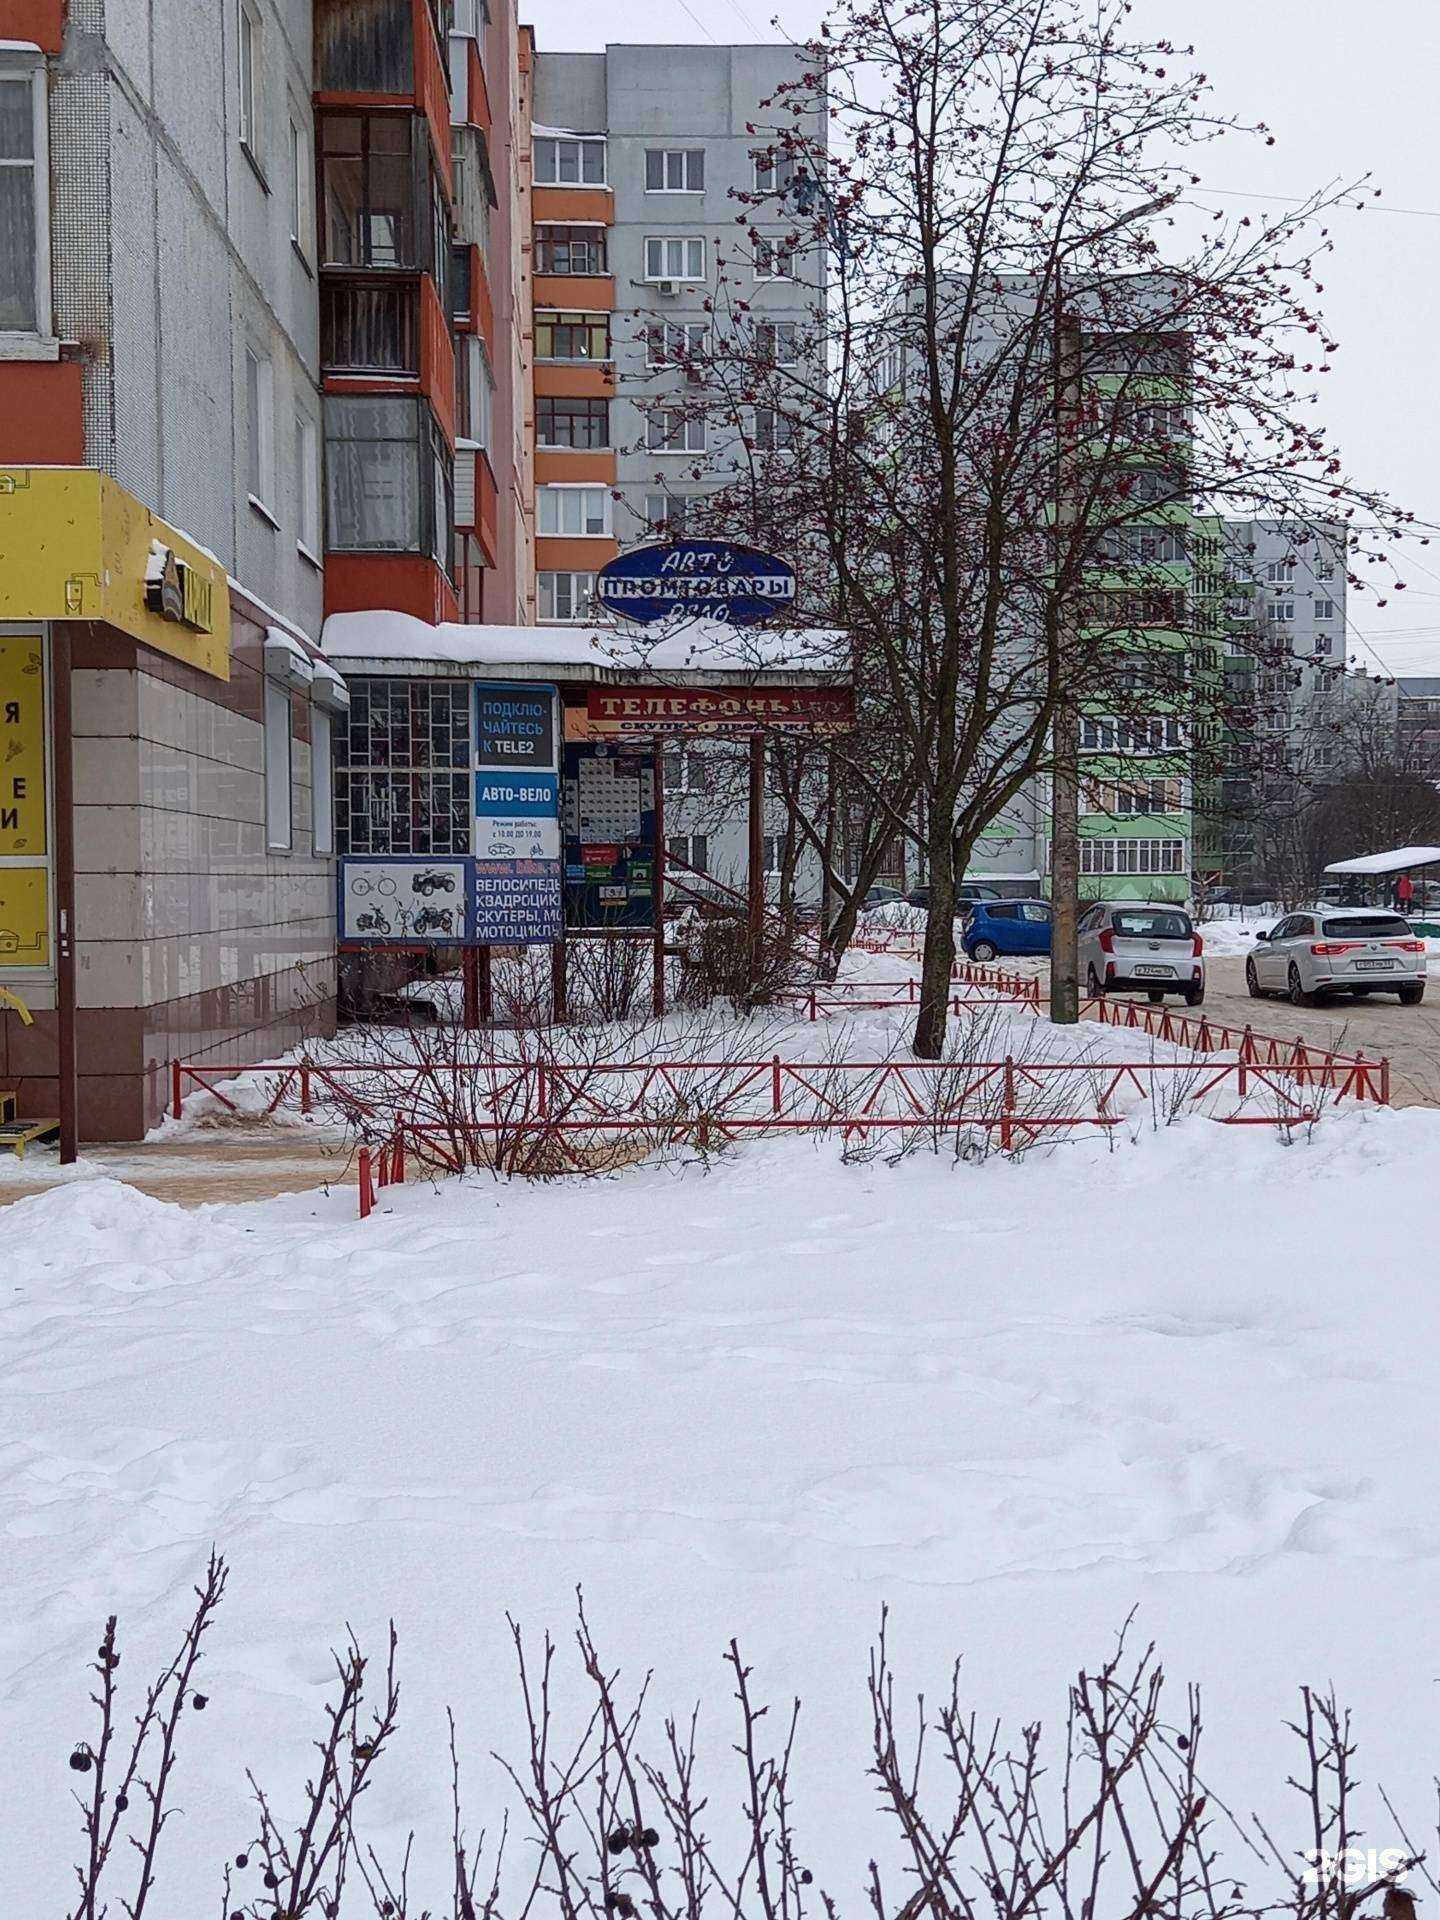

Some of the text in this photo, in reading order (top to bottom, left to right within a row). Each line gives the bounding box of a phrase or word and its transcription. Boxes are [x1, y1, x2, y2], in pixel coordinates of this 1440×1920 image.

[604, 579, 789, 596] ПРОМТОВАРЫ
[483, 702, 547, 716] ПОДКЛЮ-
[483, 720, 544, 735] ЧАЙТЕСЬ
[483, 740, 534, 754] К TELE2
[482, 787, 551, 802] АВТО-ВЕЛО
[476, 909, 540, 922] СКУТЕРЫ,
